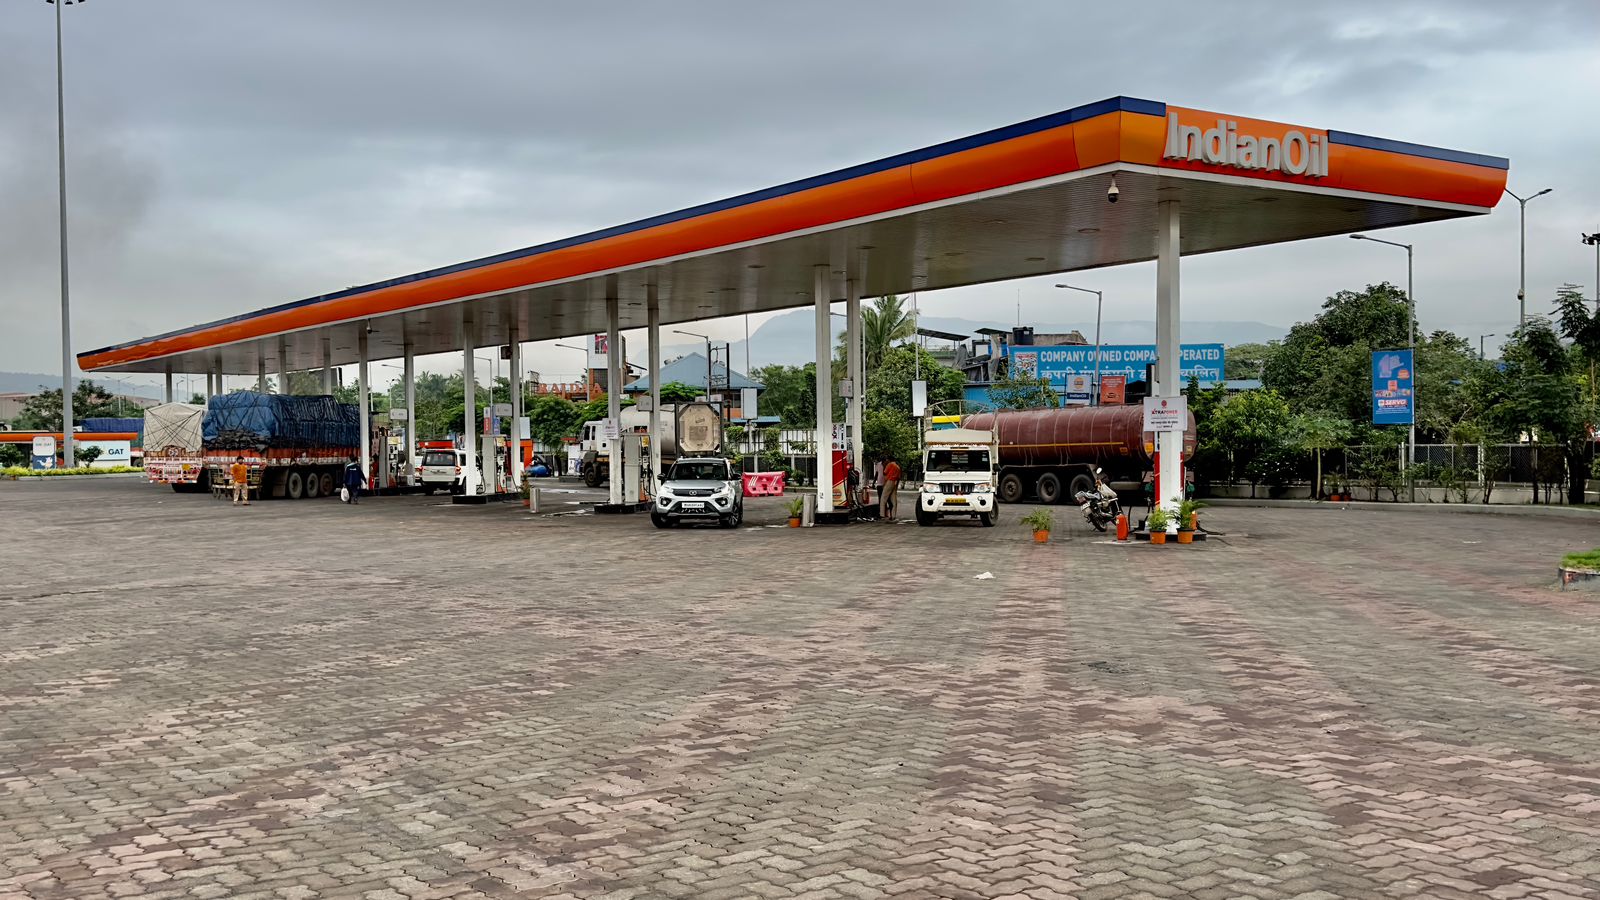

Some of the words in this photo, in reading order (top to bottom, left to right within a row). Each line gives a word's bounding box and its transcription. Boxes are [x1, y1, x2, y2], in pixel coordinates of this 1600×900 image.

[1163, 112, 1329, 177] IndianOil
[1041, 351, 1086, 362] COMPANY
[1087, 351, 1122, 362] OWNED
[1124, 350, 1156, 362] COMPA
[1179, 349, 1220, 361] PERATED
